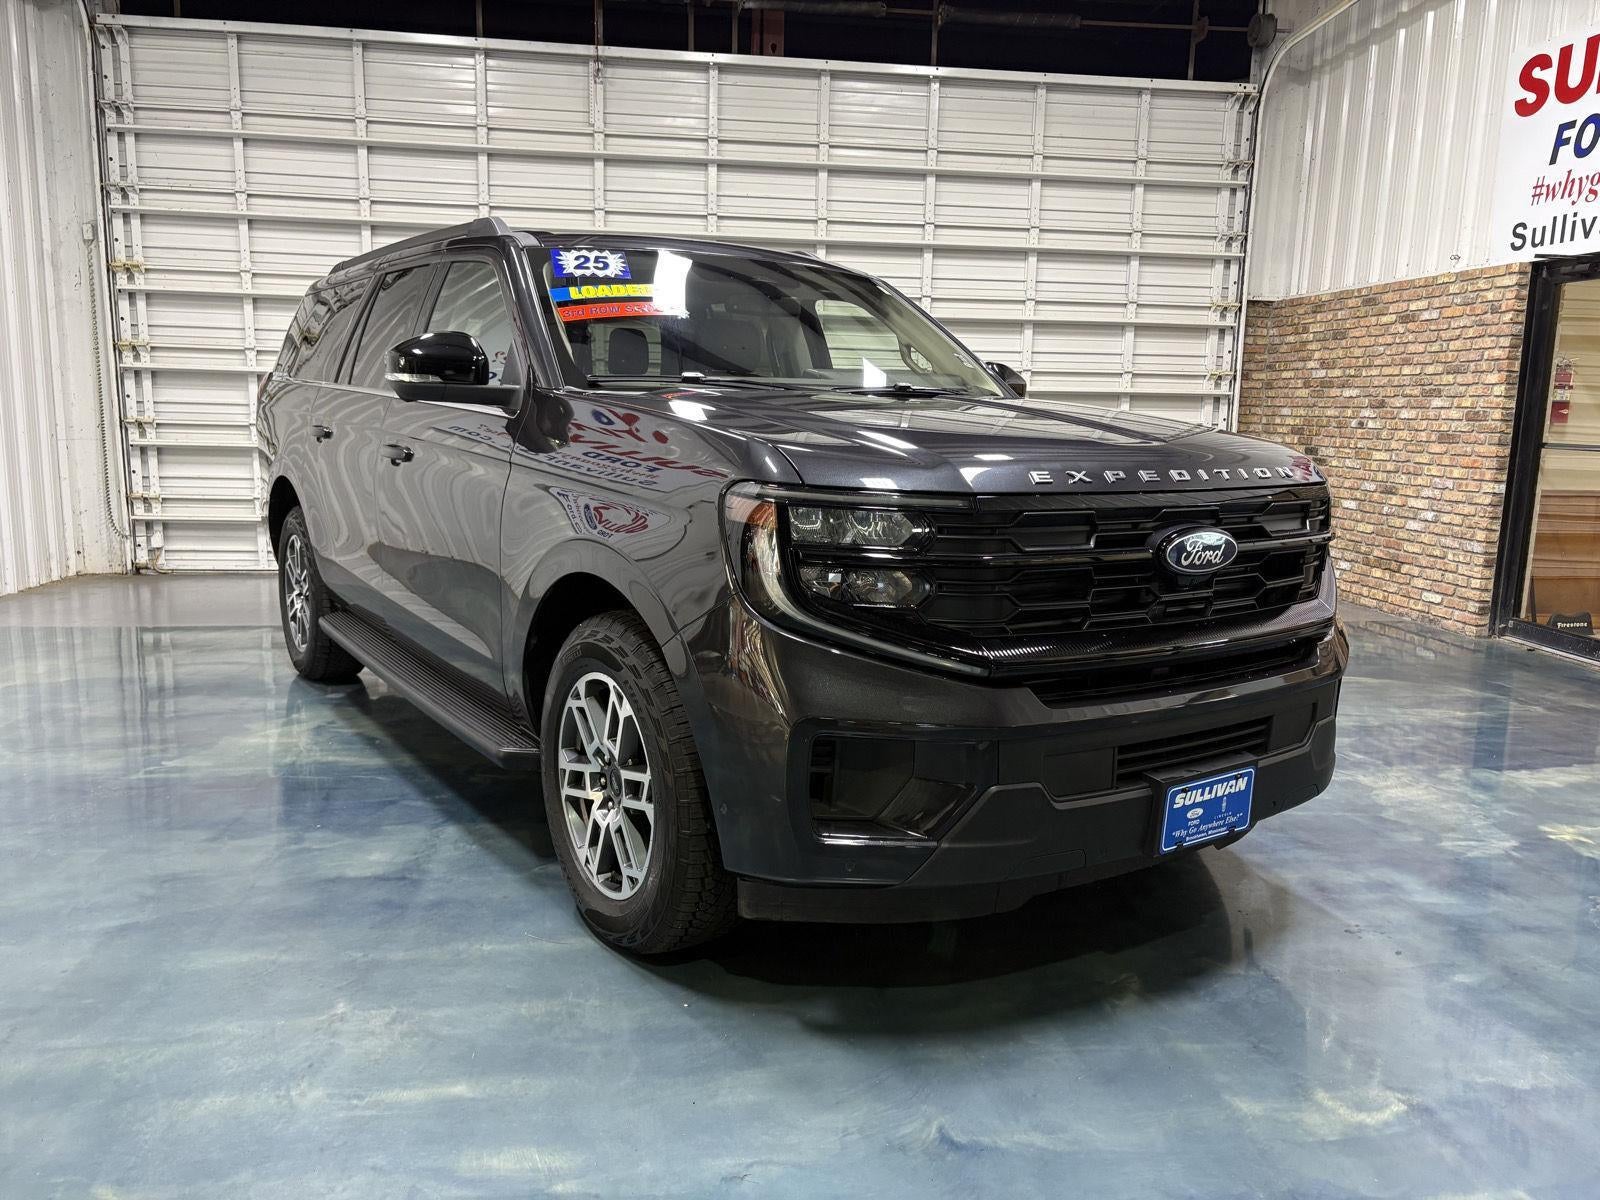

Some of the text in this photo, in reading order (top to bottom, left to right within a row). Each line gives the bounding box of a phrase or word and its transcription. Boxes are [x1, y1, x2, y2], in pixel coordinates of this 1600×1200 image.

[1515, 33, 1600, 118] SU
[1510, 212, 1600, 251] Sulliv
[573, 254, 610, 271] 25
[1028, 466, 1294, 485] EXPEDITION
[1181, 535, 1225, 566] Ford
[1173, 777, 1248, 808] SULLIVAN
